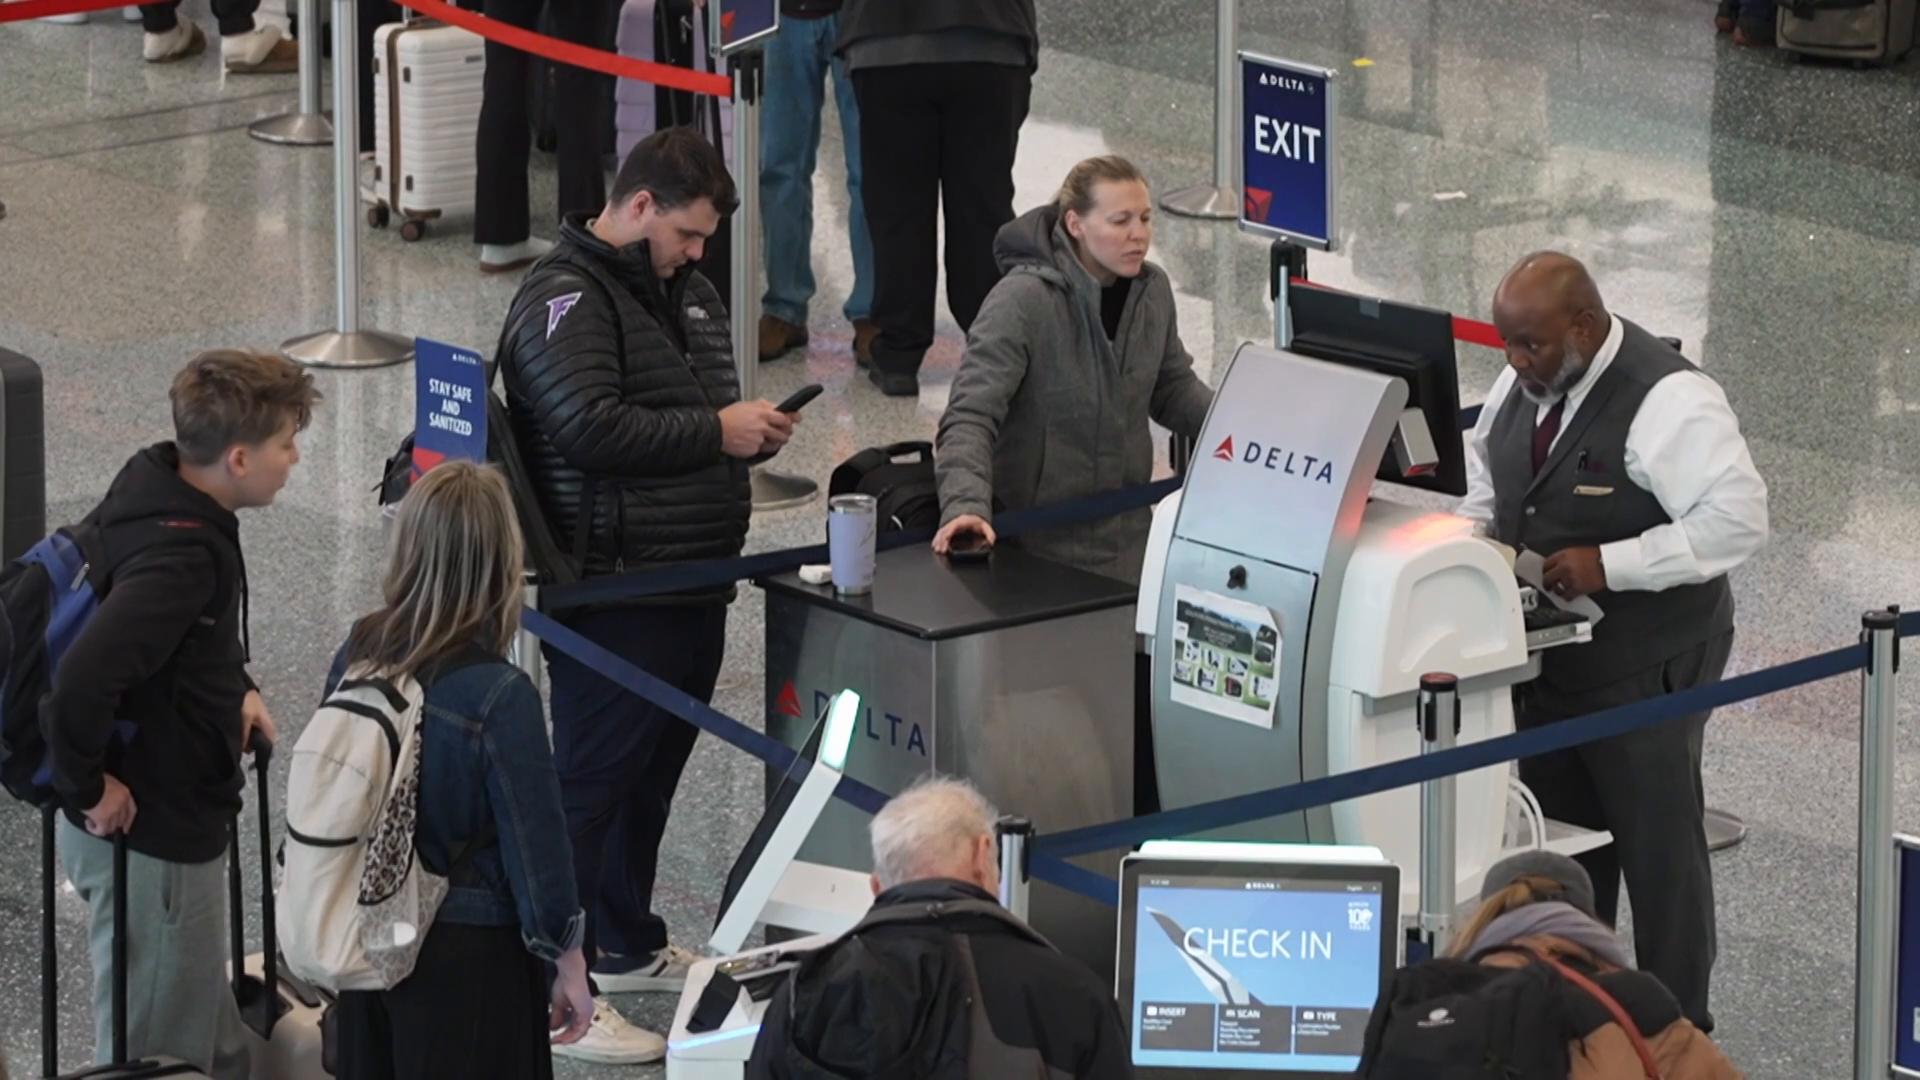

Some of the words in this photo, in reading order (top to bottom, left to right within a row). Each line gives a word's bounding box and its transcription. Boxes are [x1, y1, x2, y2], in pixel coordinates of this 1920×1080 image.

[1270, 74, 1305, 92] DELTA
[1255, 114, 1321, 164] EXIT
[429, 378, 450, 397] STAY
[452, 384, 472, 403] SAFE
[442, 398, 460, 416] AND
[429, 411, 472, 436] SANITIZED
[1243, 441, 1332, 484] DELTA
[814, 689, 926, 756] DLTA
[1184, 926, 1291, 959] CHECK
[1300, 930, 1332, 960] IN
[1159, 1007, 1186, 1017] INSERT
[1237, 1009, 1260, 1018] SCAN
[1316, 1011, 1337, 1021] TYPE
